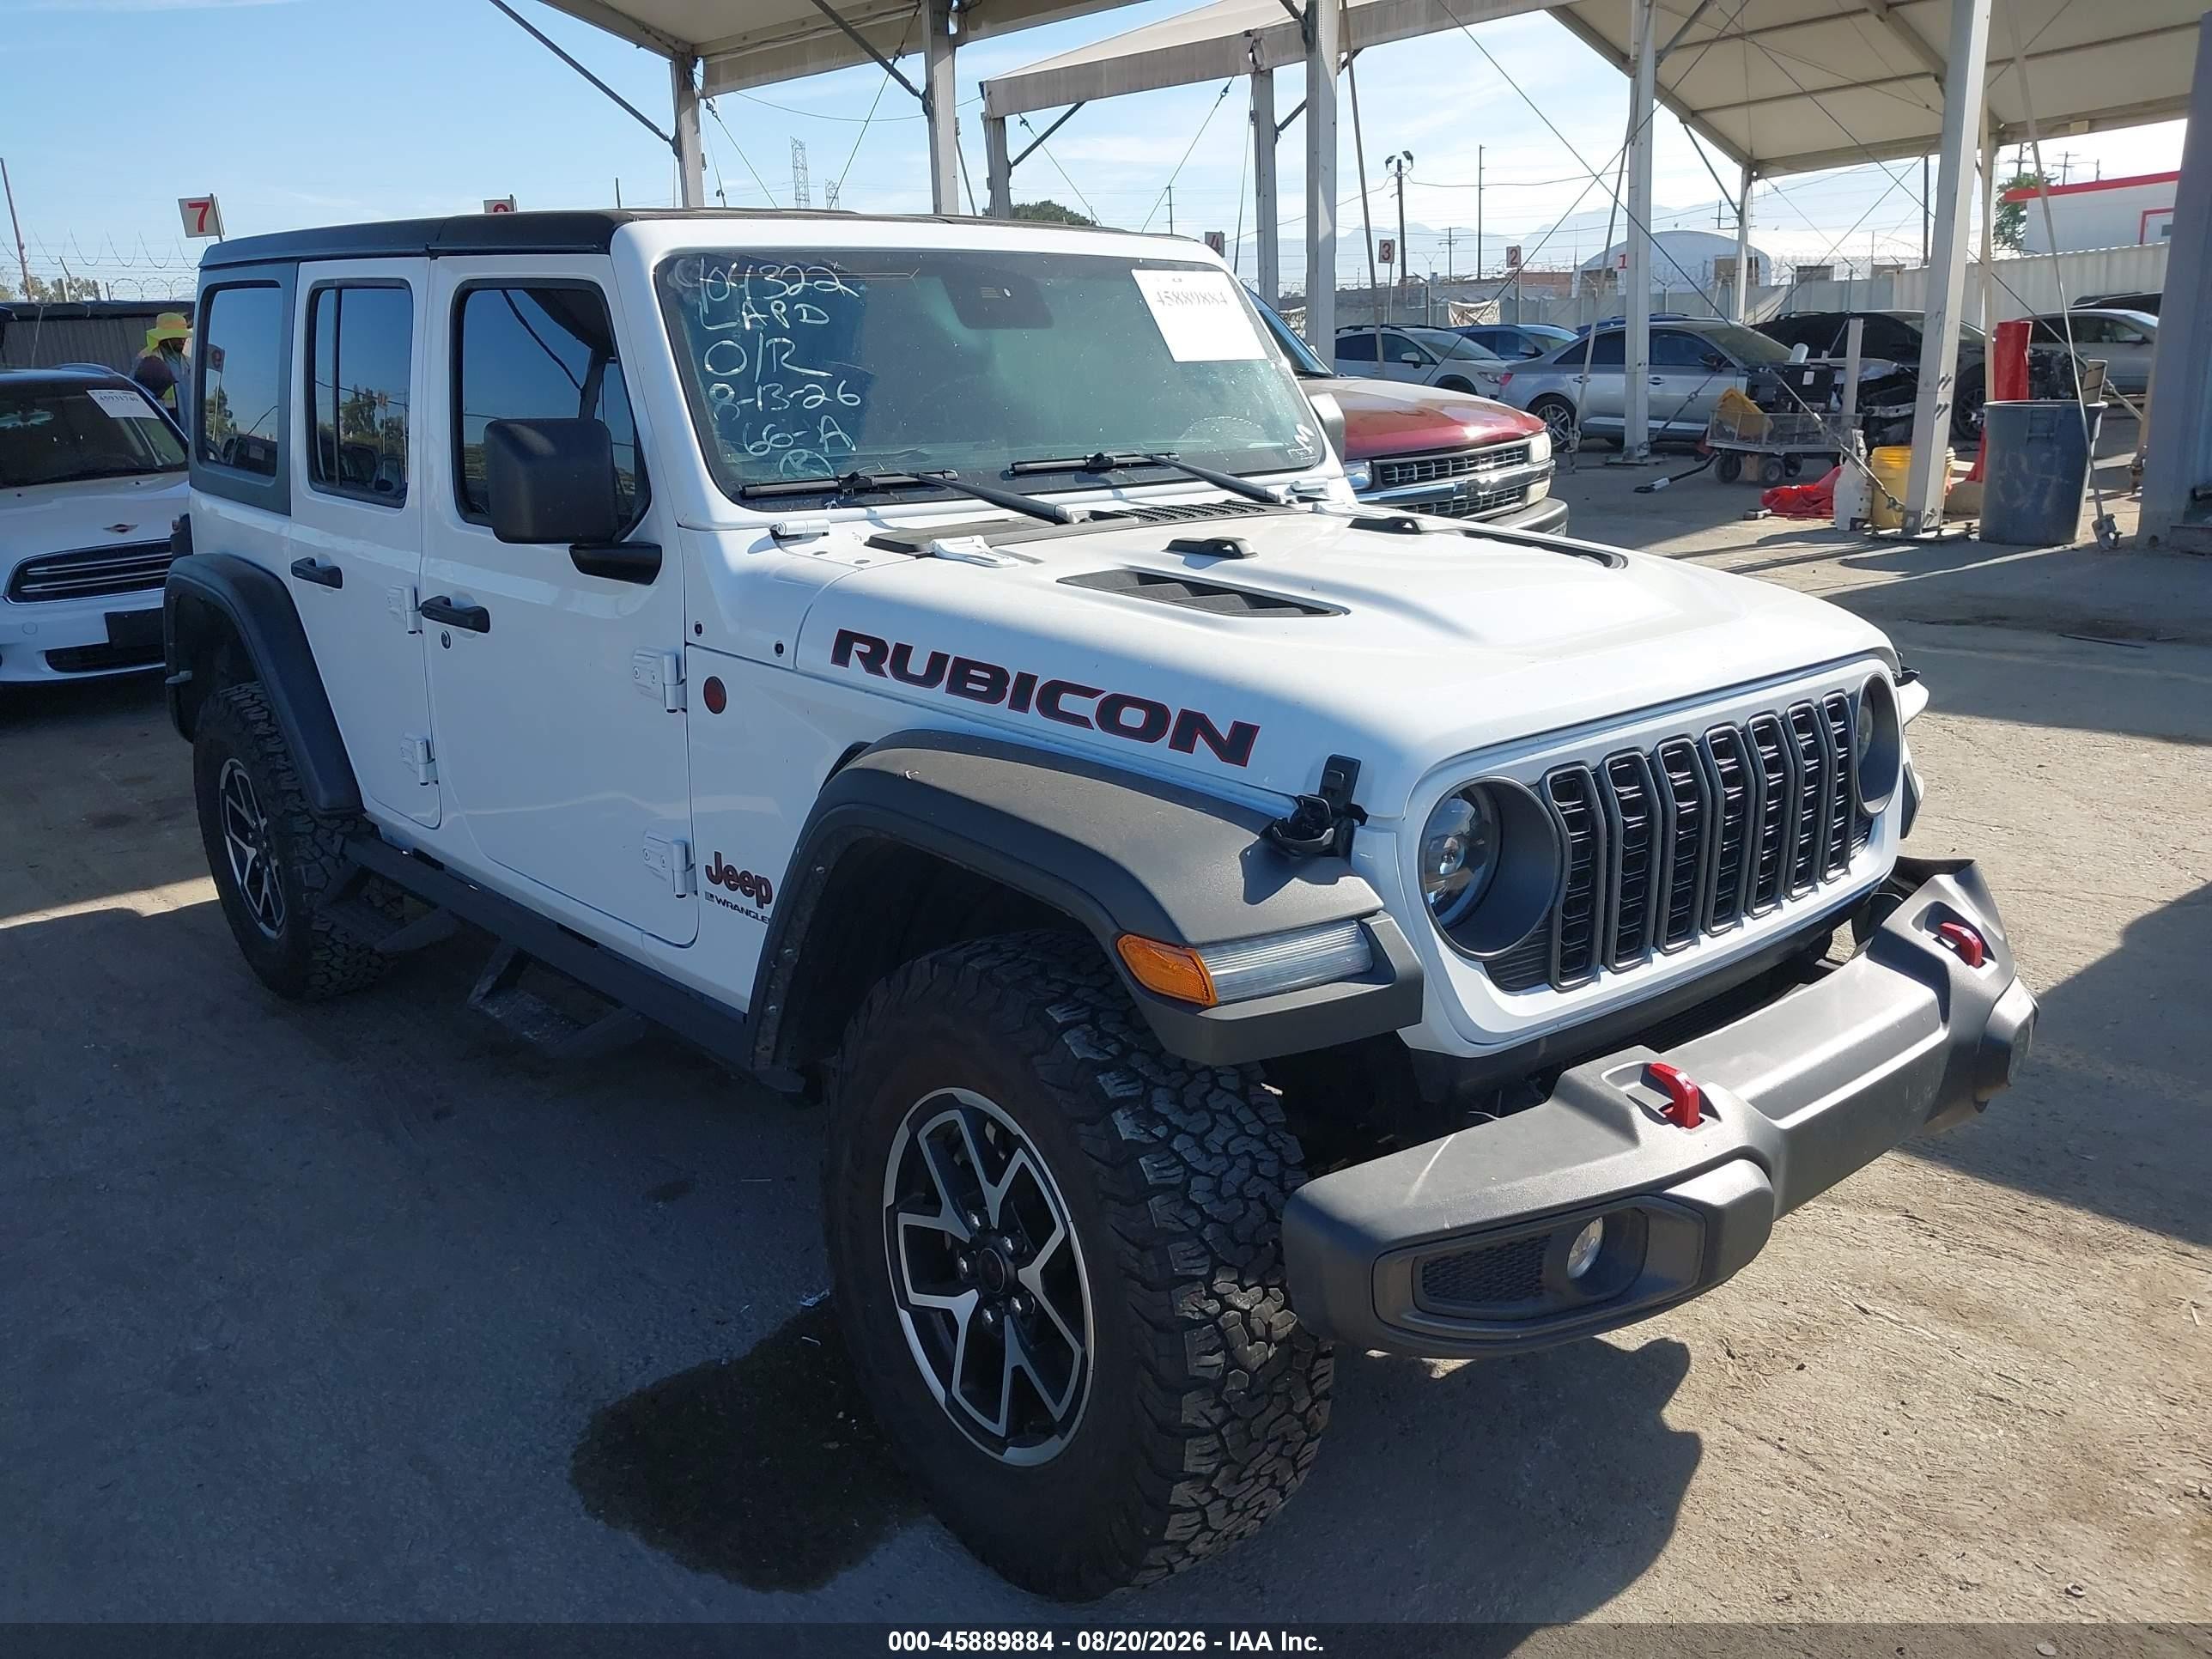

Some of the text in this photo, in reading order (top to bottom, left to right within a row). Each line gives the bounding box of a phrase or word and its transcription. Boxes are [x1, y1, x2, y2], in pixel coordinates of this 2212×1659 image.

[187, 202, 210, 233] 7
[1382, 242, 1391, 261] 3
[1510, 248, 1519, 265] 2
[1618, 253, 1628, 270] 1
[703, 331, 834, 383] O/R
[830, 628, 1261, 768] RUBICON
[705, 851, 773, 909] Jeep
[714, 895, 770, 925] WRANGLE
